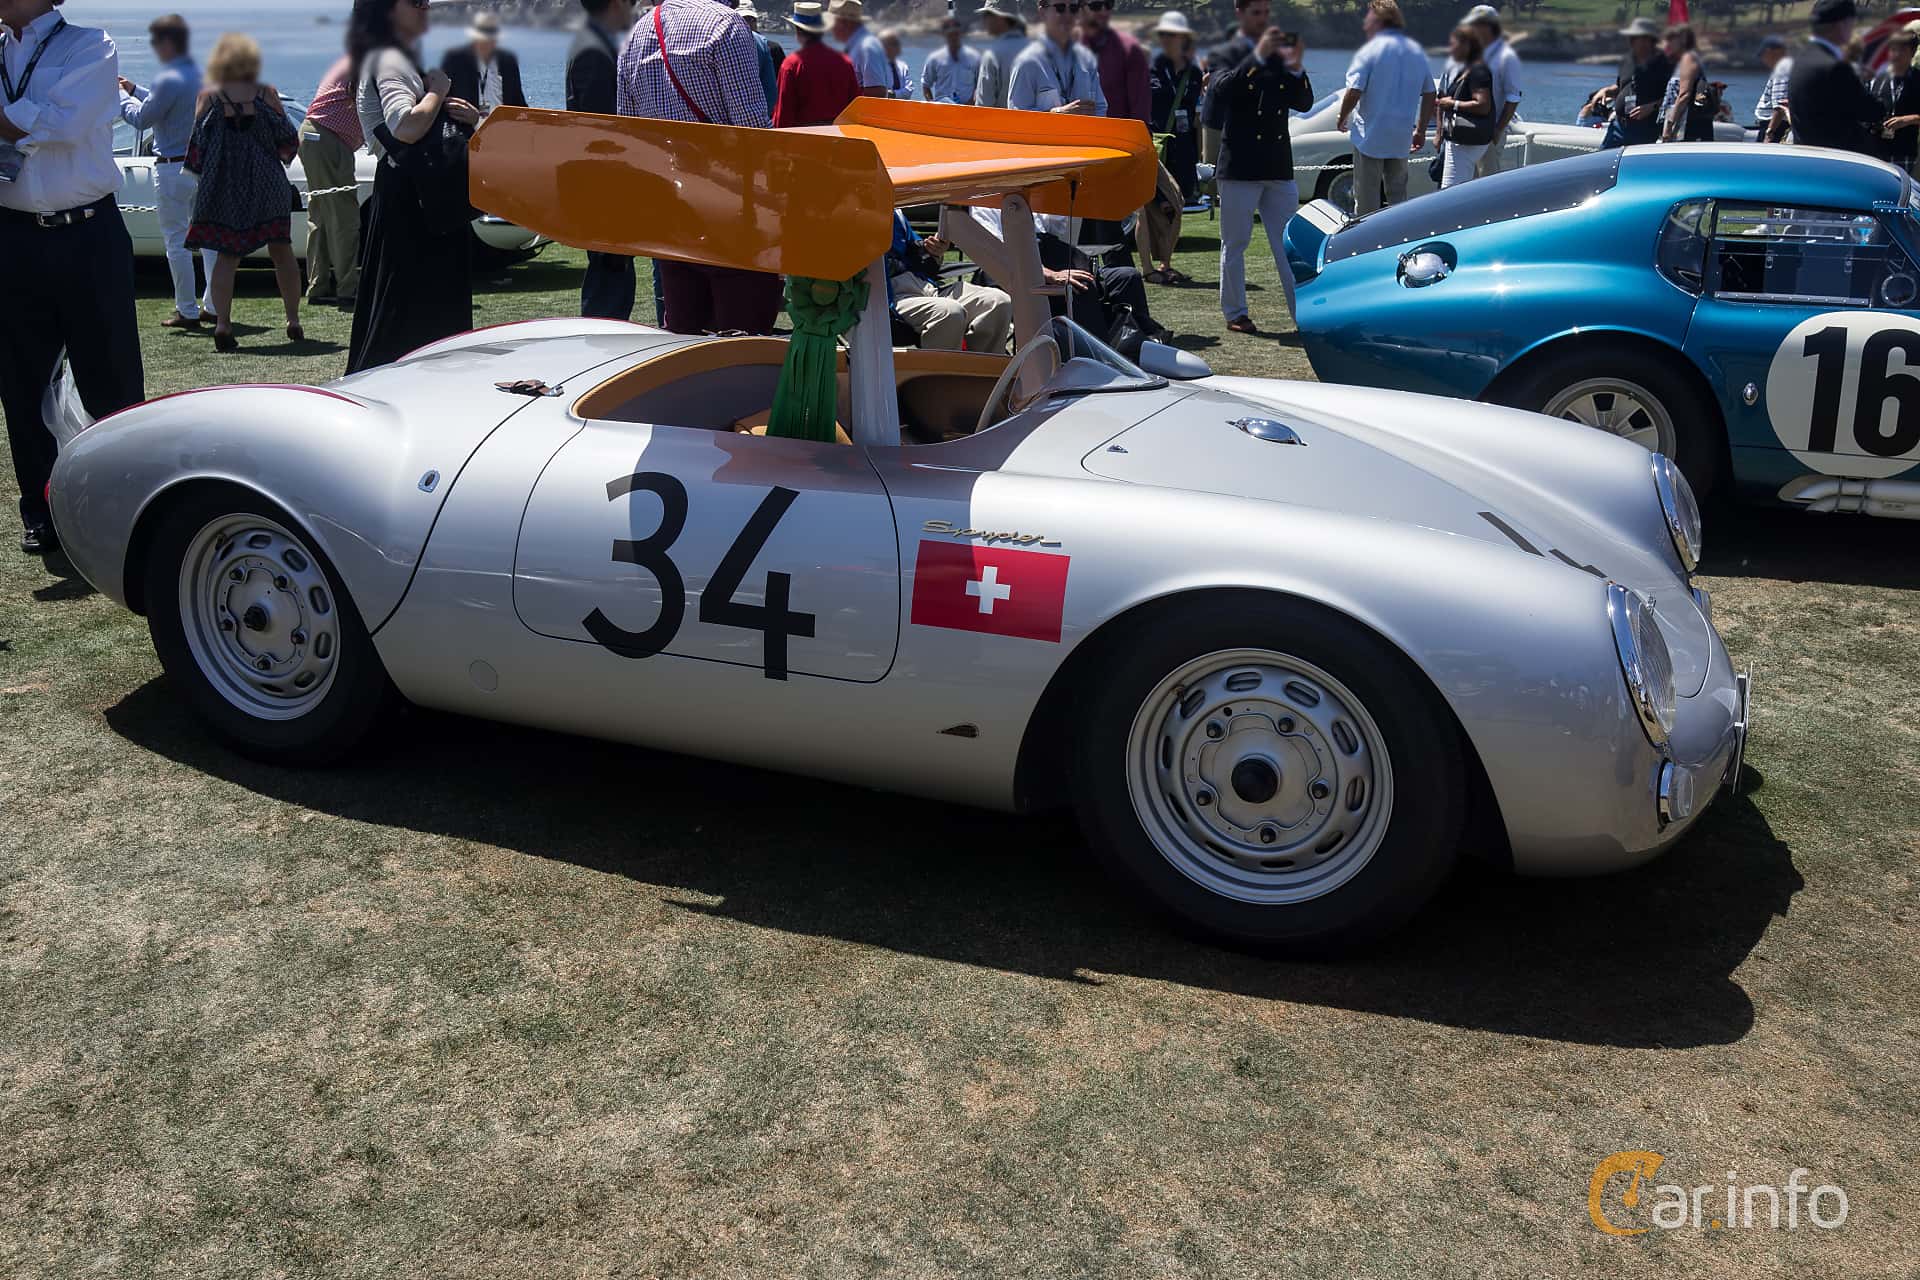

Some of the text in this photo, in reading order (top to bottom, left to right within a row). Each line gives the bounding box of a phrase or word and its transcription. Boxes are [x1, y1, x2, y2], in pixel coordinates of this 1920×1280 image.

[1803, 326, 1920, 457] 16
[582, 472, 815, 681] 34
[921, 519, 1062, 547] Spyder
